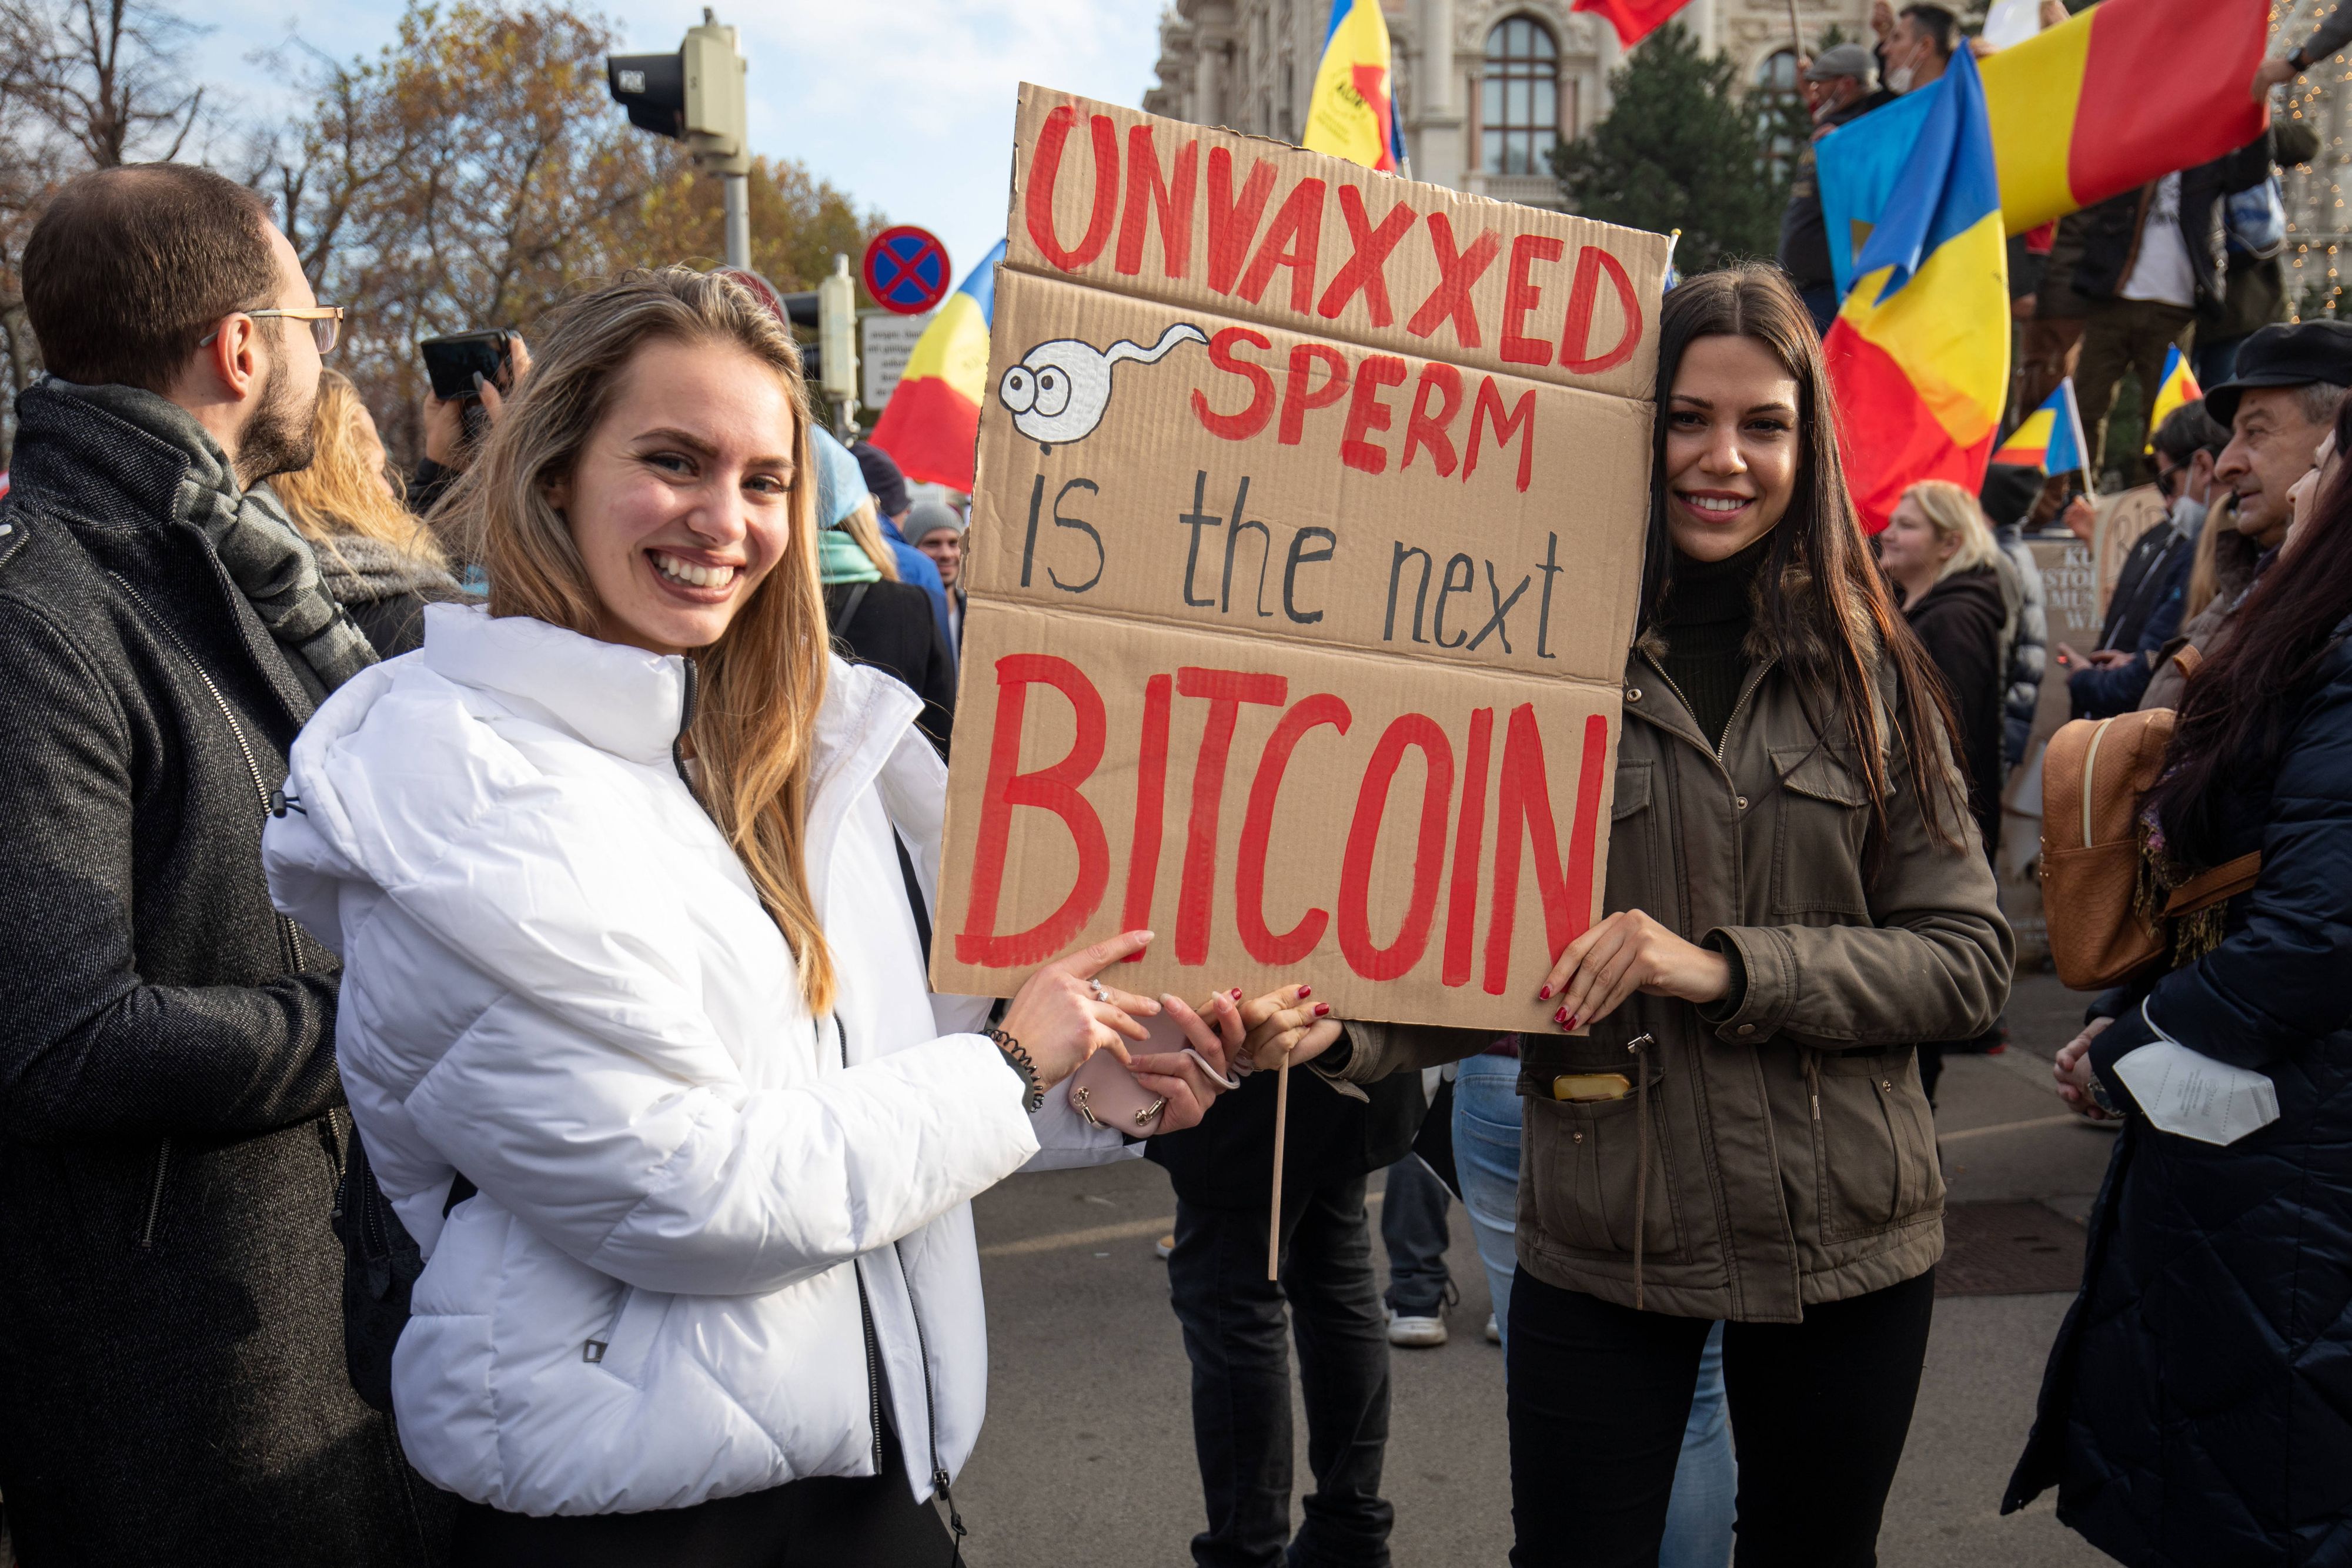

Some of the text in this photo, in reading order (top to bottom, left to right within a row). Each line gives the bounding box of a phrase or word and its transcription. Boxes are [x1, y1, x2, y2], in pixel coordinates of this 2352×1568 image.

[1025, 105, 1643, 374] UNVAXXED
[1191, 327, 1536, 493] SPERM
[1180, 470, 1337, 624] the
[1384, 531, 1564, 659] next
[955, 653, 1608, 996] BITCOIN
